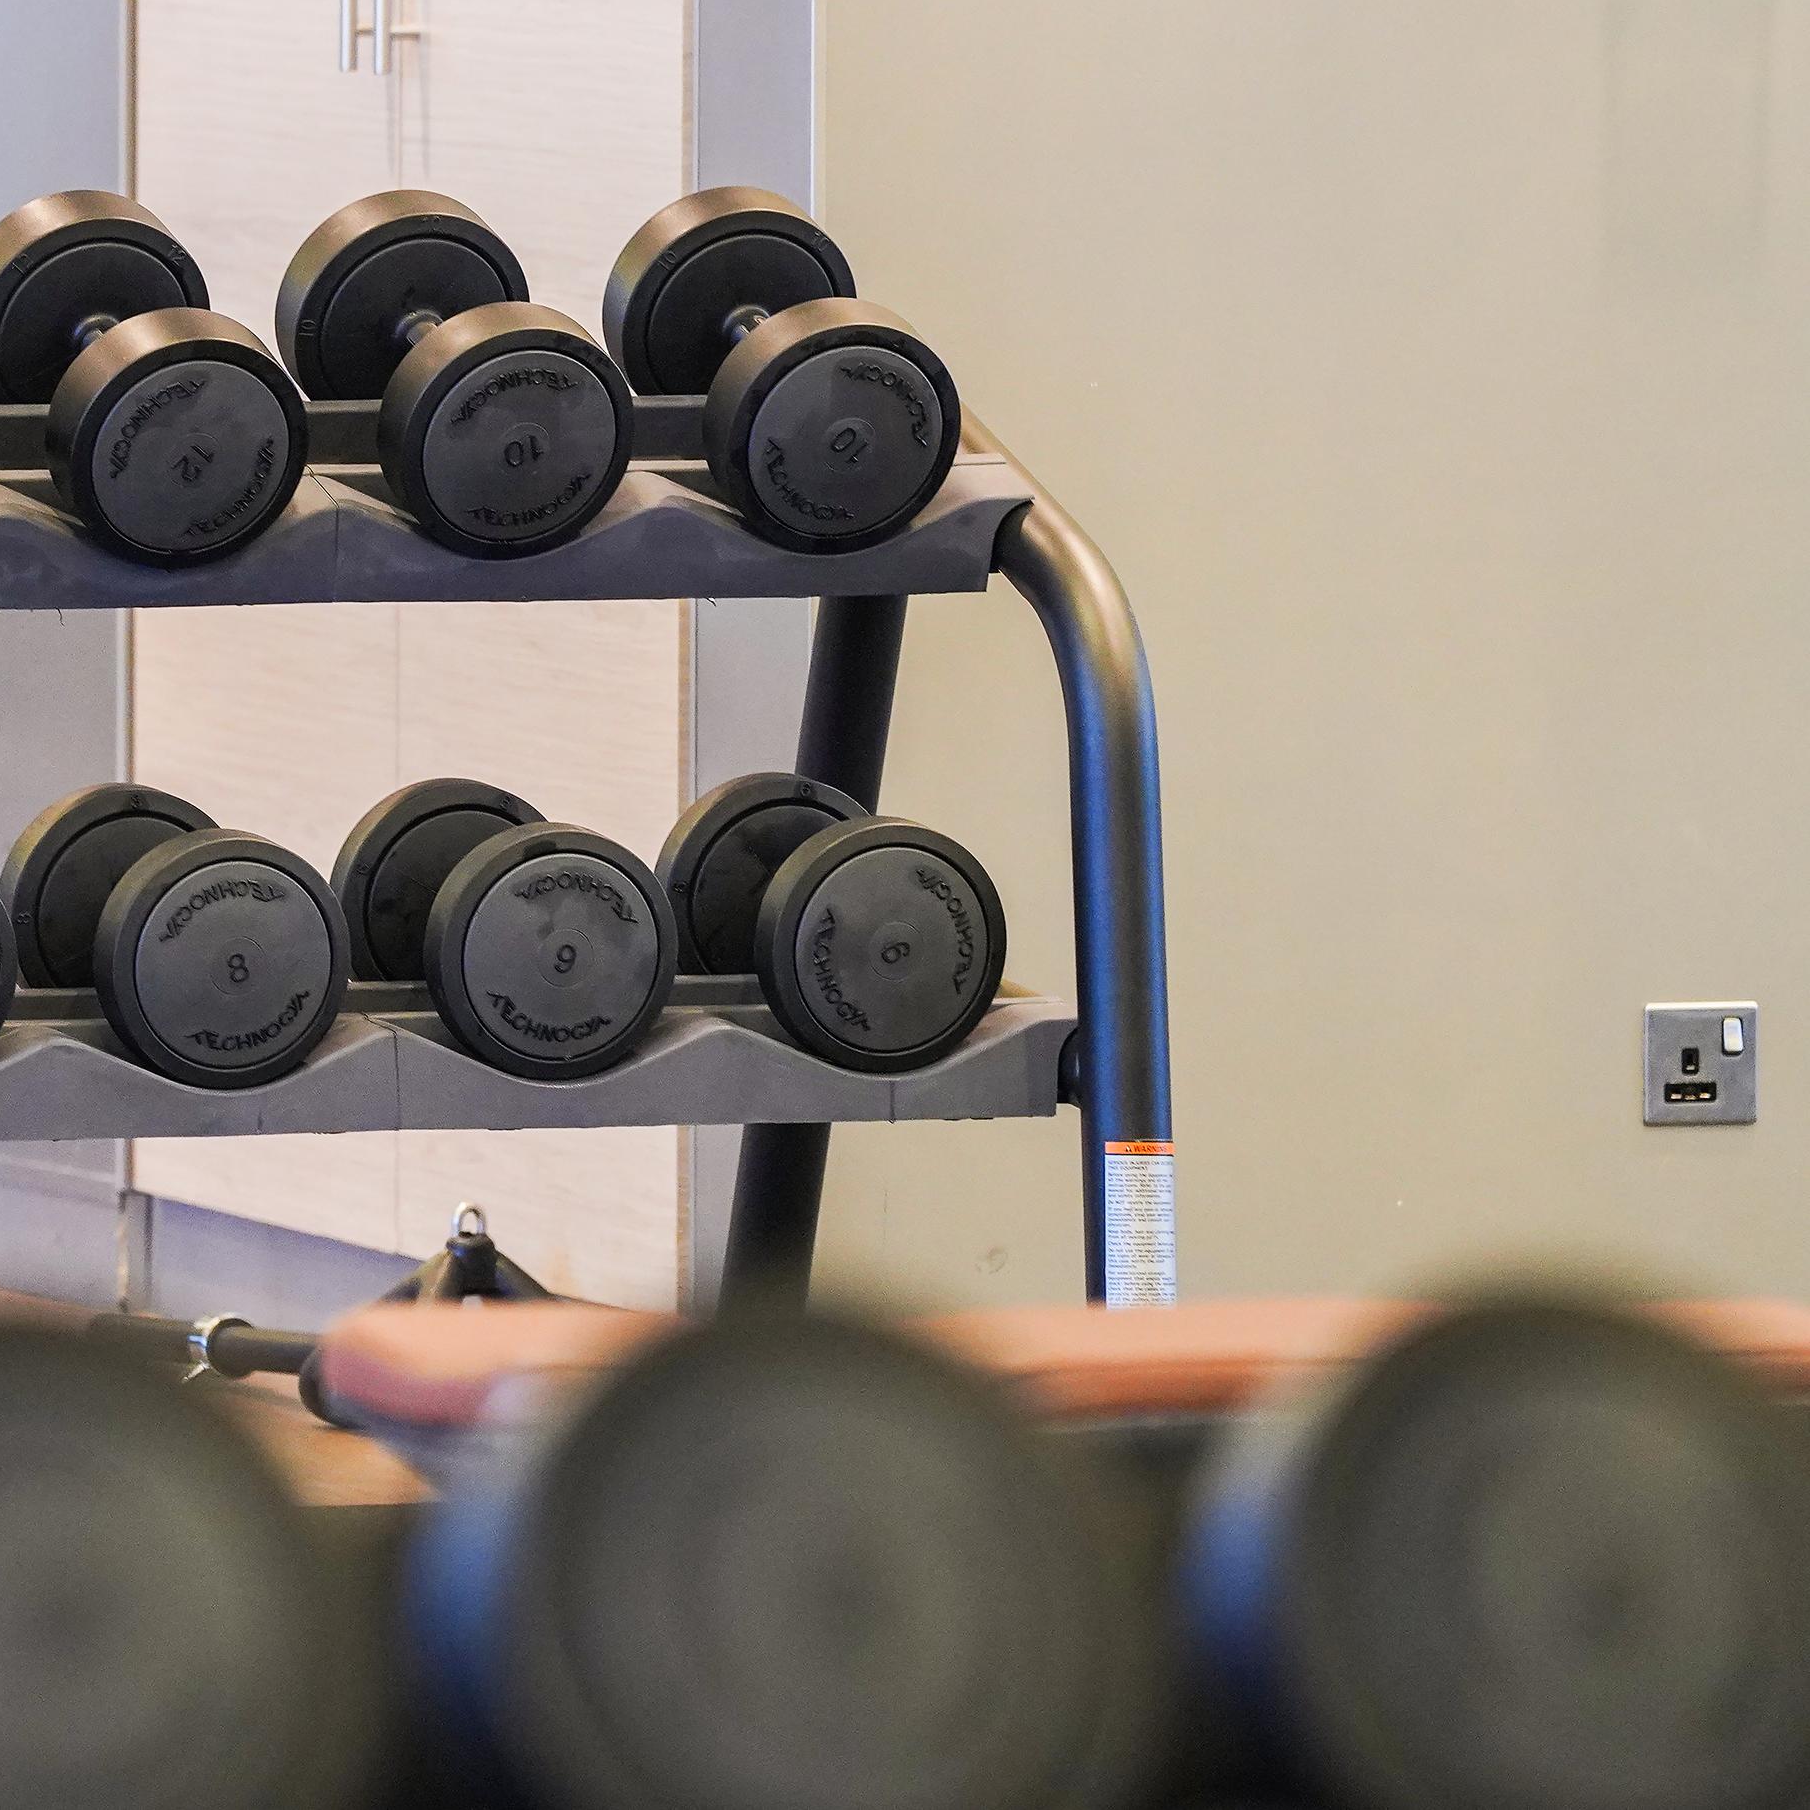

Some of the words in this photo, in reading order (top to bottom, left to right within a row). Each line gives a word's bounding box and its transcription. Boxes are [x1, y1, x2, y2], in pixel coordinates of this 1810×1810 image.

[503, 434, 545, 469] 10
[831, 426, 870, 464] 10
[227, 952, 250, 984] 8
